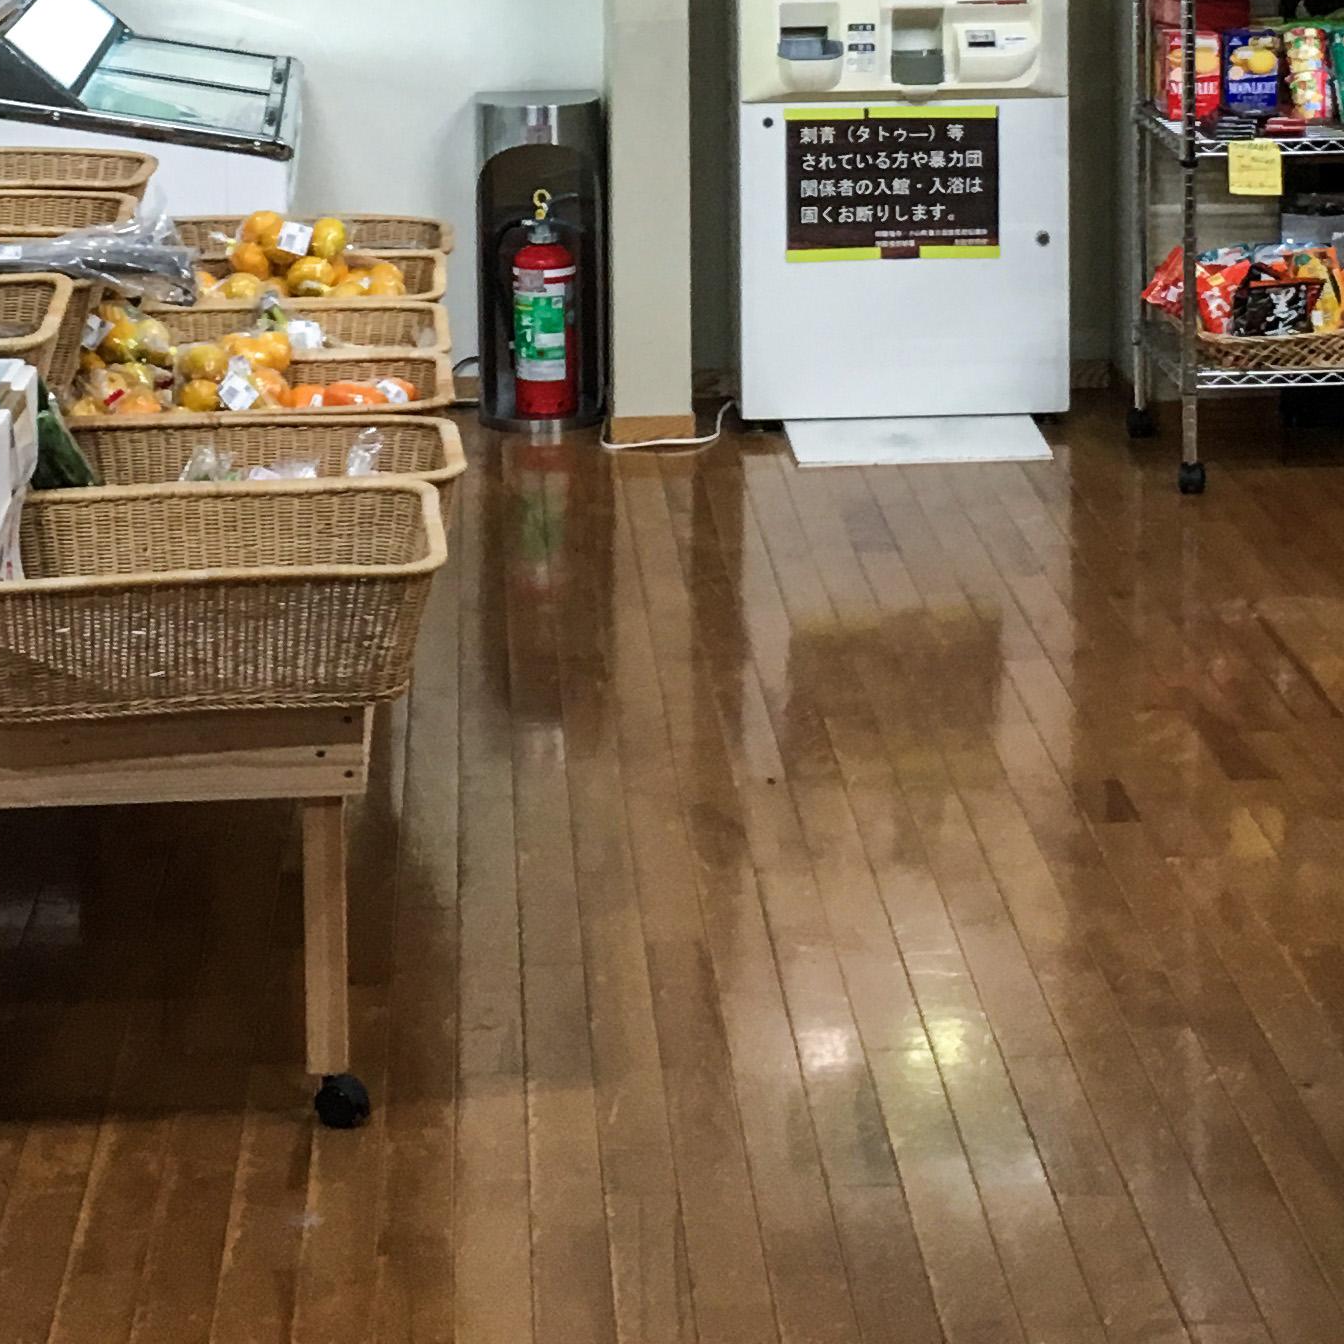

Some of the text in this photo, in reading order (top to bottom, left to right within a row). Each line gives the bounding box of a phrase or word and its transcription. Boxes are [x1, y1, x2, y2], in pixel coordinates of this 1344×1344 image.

[802, 150, 984, 170] されている方や暴力団
[801, 177, 983, 197] 関係者の入館・入浴は
[801, 203, 956, 224] 固くお断りします。
